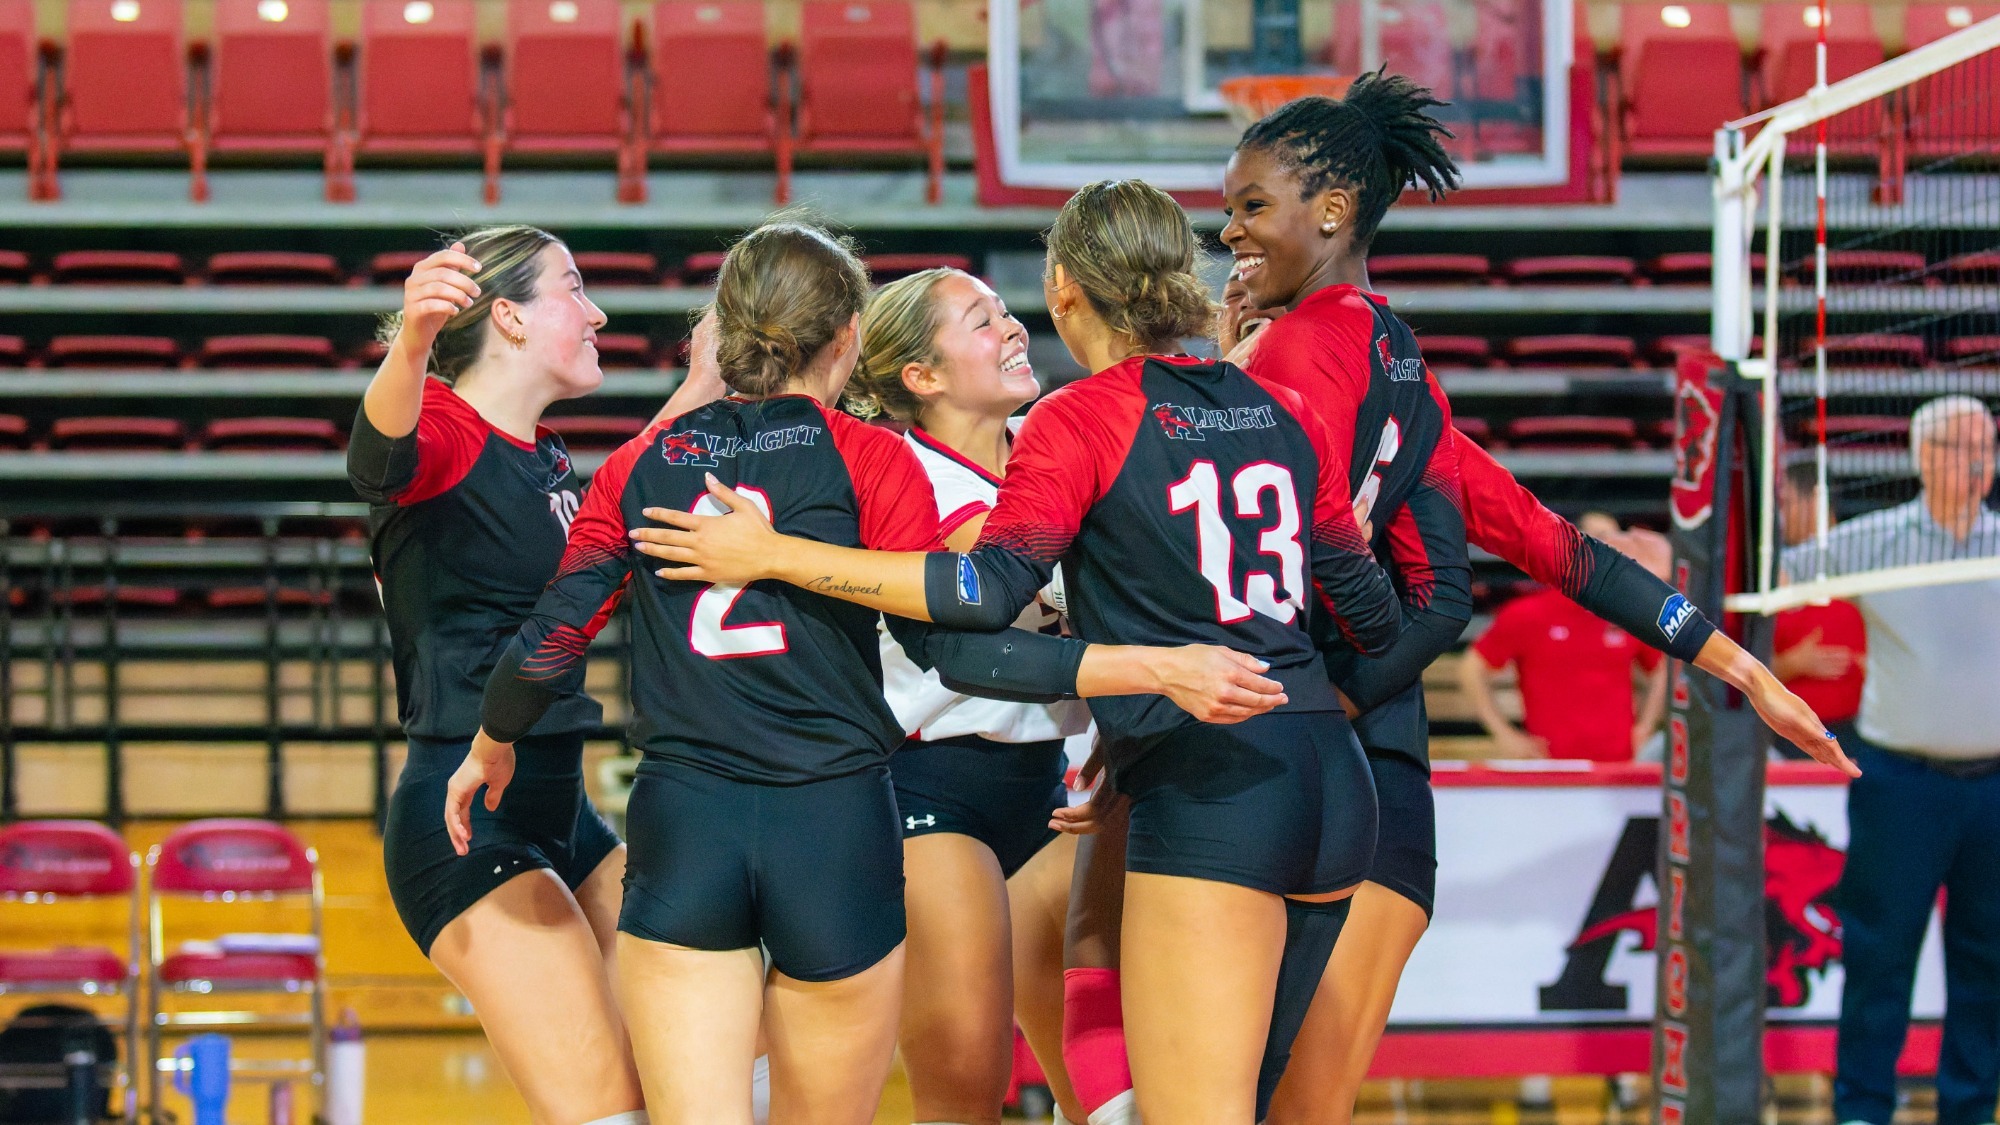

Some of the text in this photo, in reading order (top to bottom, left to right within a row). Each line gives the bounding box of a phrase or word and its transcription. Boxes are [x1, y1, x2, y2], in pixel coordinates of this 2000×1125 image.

[688, 482, 789, 660] 2
[805, 576, 882, 596] Godspeed
[1167, 459, 1305, 625] 13
[1664, 600, 1695, 637] MAC
